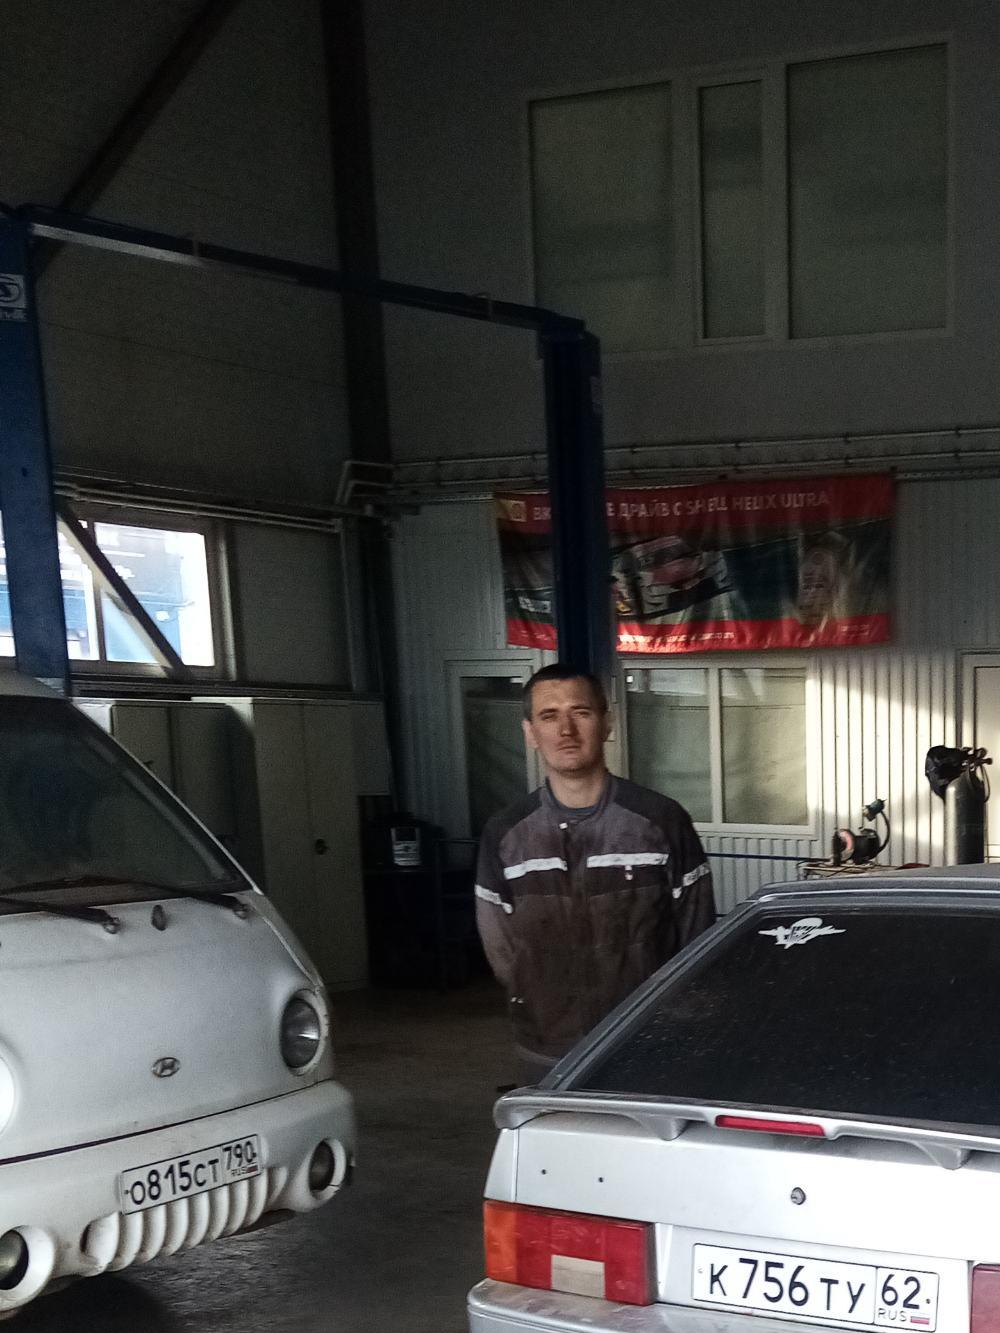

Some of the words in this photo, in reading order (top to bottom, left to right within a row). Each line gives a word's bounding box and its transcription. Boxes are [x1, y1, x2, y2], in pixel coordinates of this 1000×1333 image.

[618, 499, 670, 520] ДРАЙВ
[686, 496, 729, 516] SHELL
[732, 494, 777, 511] HELIX
[780, 491, 830, 509] ULTRA
[222, 1141, 255, 1170] 790
[881, 1274, 921, 1310] 62
[877, 1308, 907, 1322] RUS
